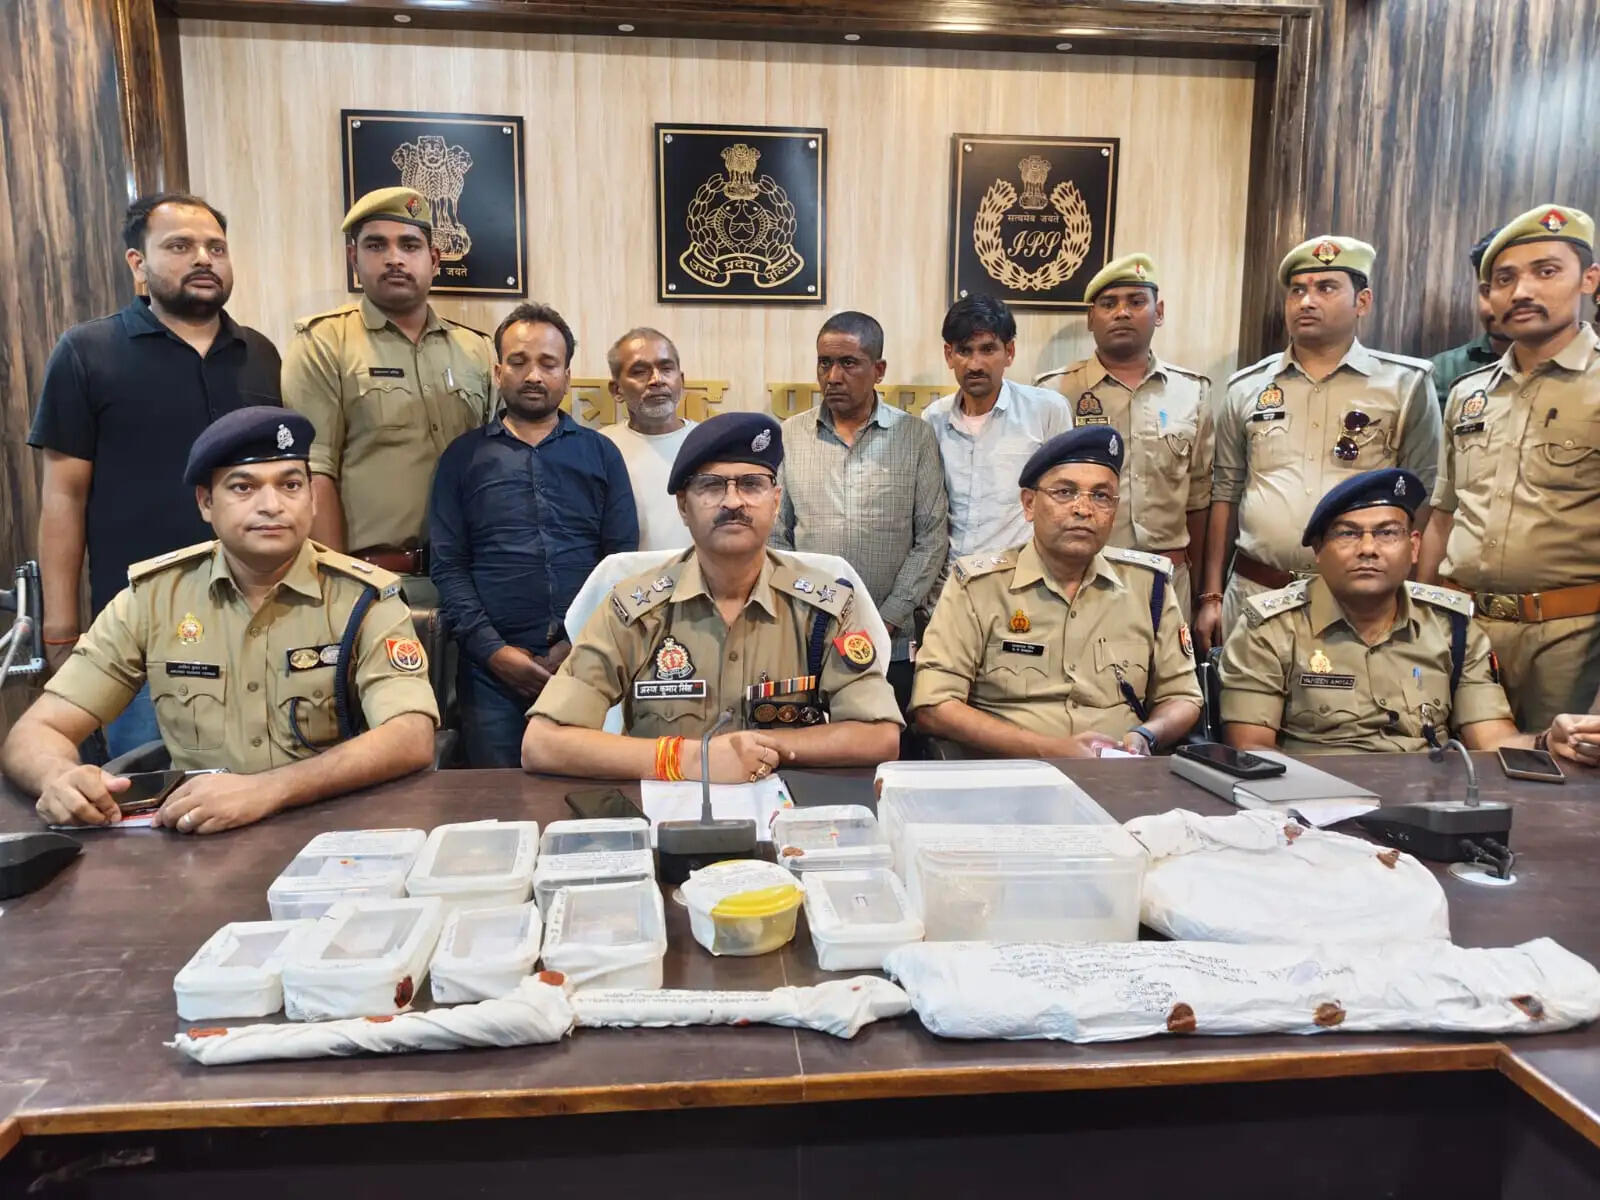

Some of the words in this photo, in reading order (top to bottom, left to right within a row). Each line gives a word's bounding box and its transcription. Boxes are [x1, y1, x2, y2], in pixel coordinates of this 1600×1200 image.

[1040, 212, 1060, 224] जयते
[1007, 230, 1062, 258] IPS
[446, 264, 468, 278] जयते
[689, 258, 718, 281] उत्तर
[723, 256, 760, 272] प्रदेश
[764, 257, 797, 284] पुलिस
